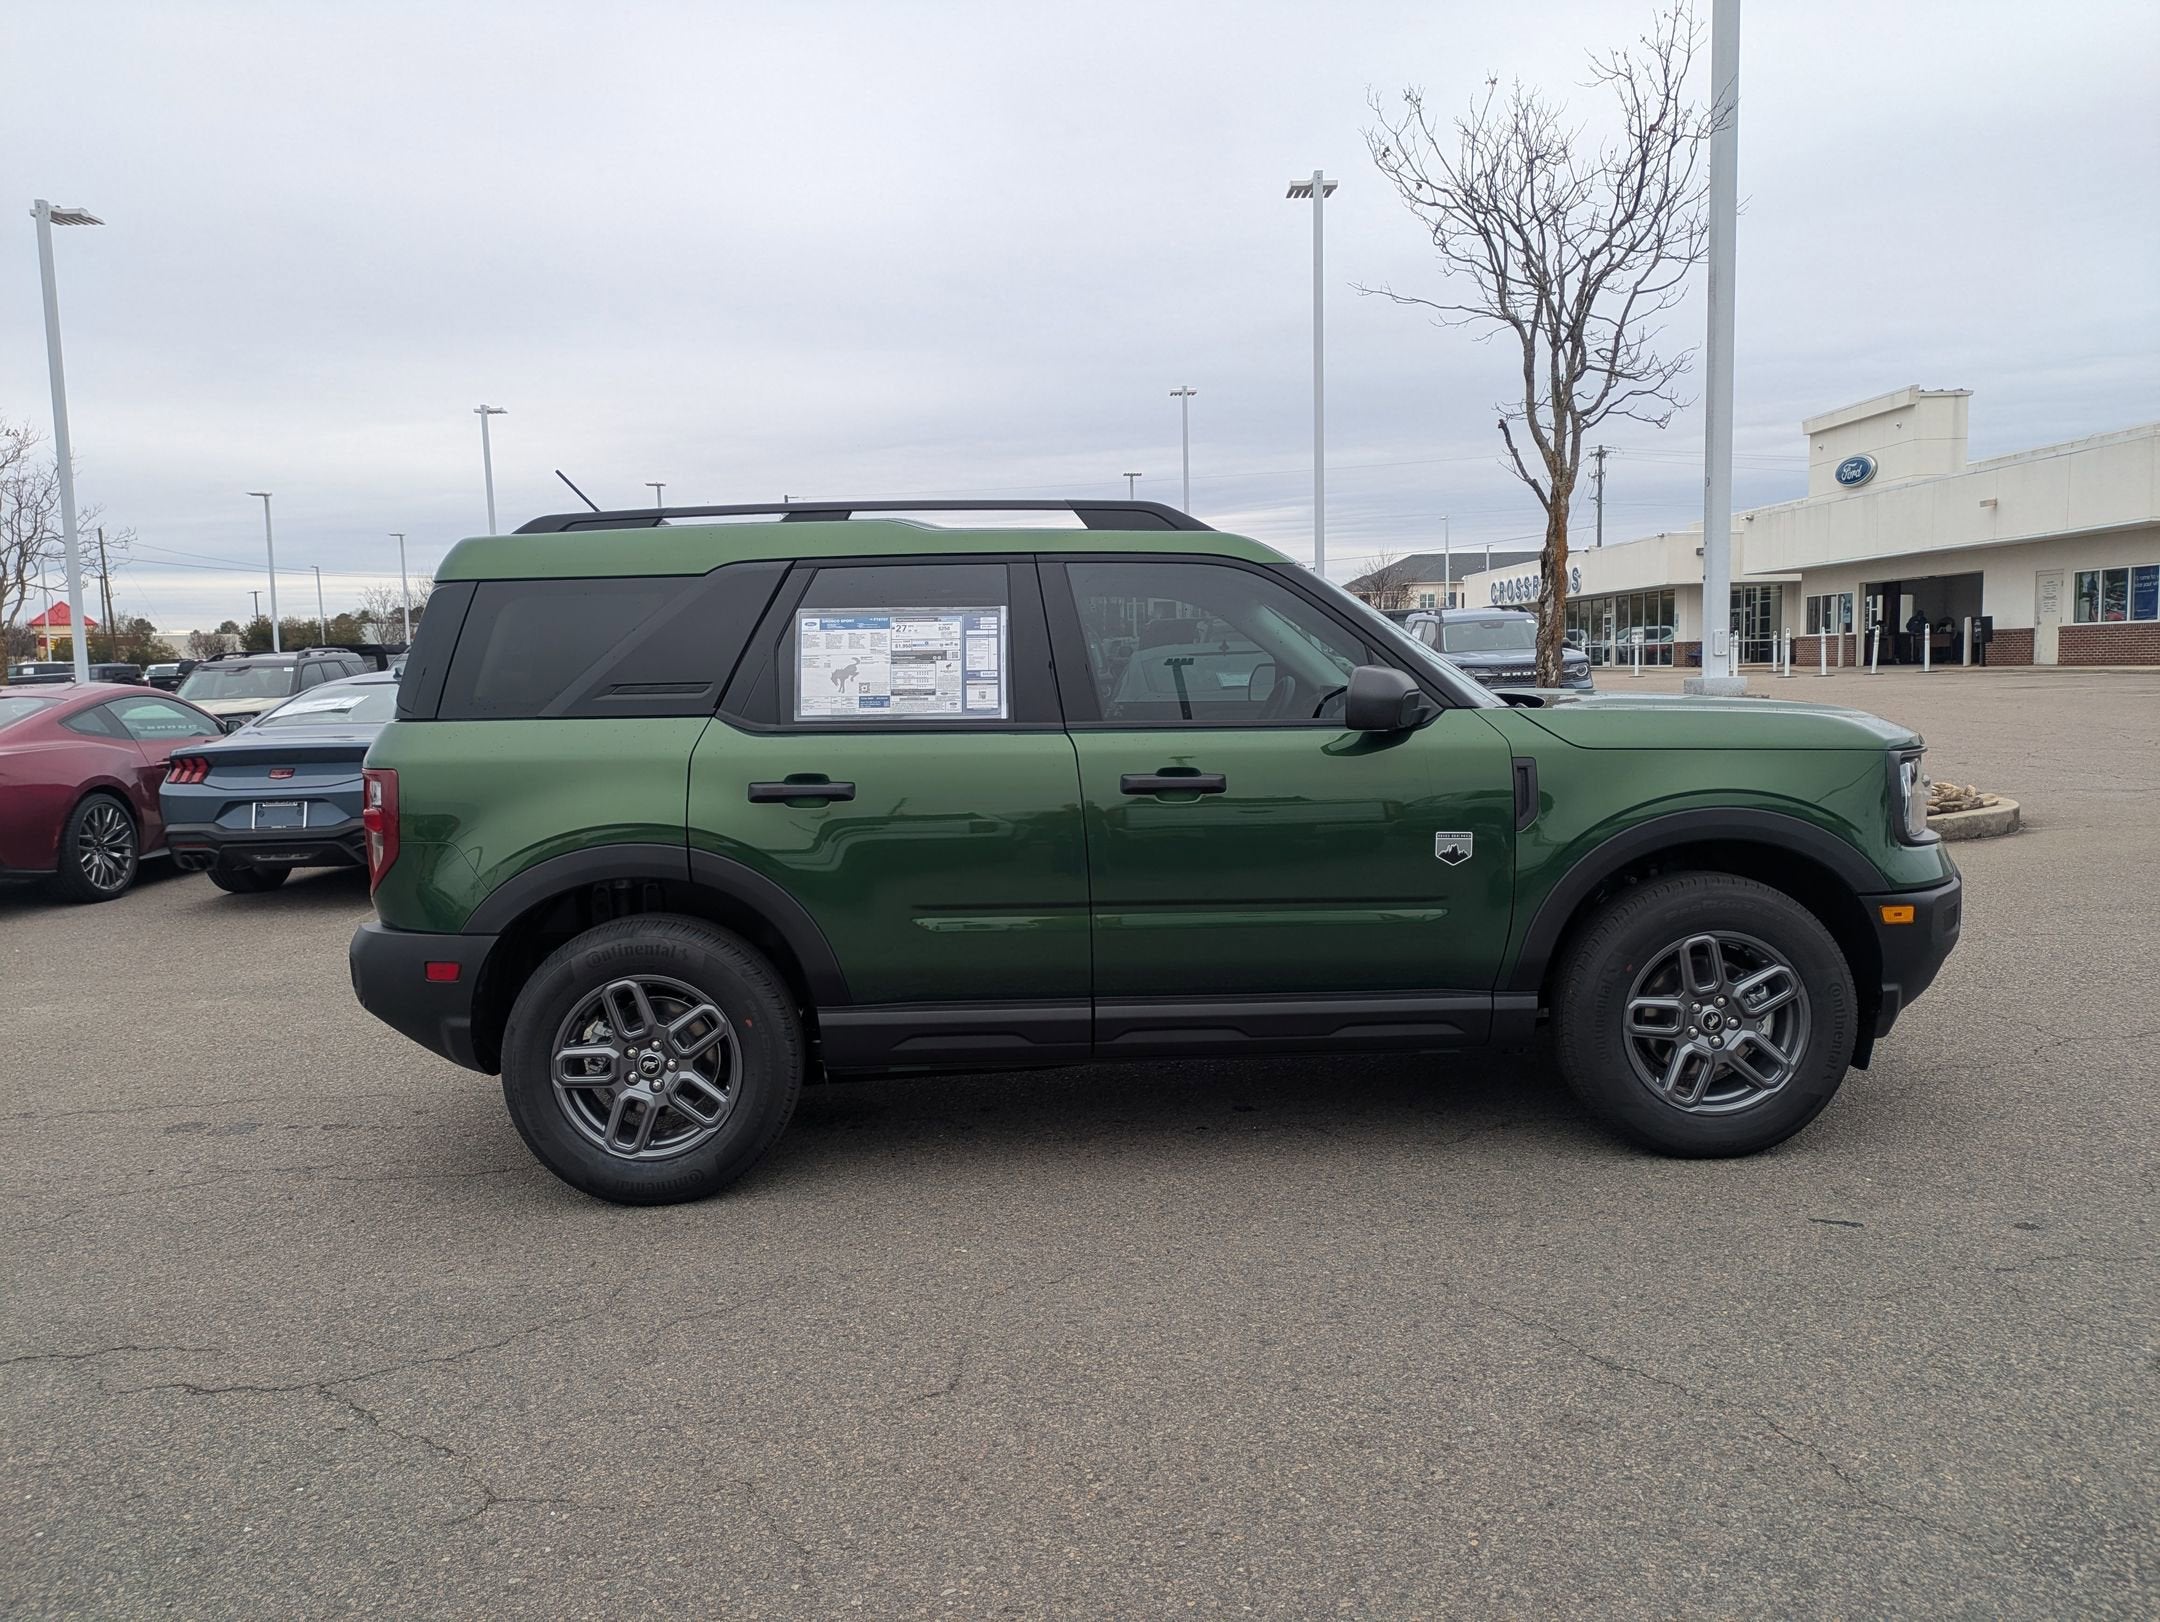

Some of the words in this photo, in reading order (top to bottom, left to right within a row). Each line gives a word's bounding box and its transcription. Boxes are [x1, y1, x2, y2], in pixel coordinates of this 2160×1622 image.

[1491, 567, 1581, 605] CROSSRS
[895, 624, 907, 633] 27
[585, 943, 677, 968] Continental
